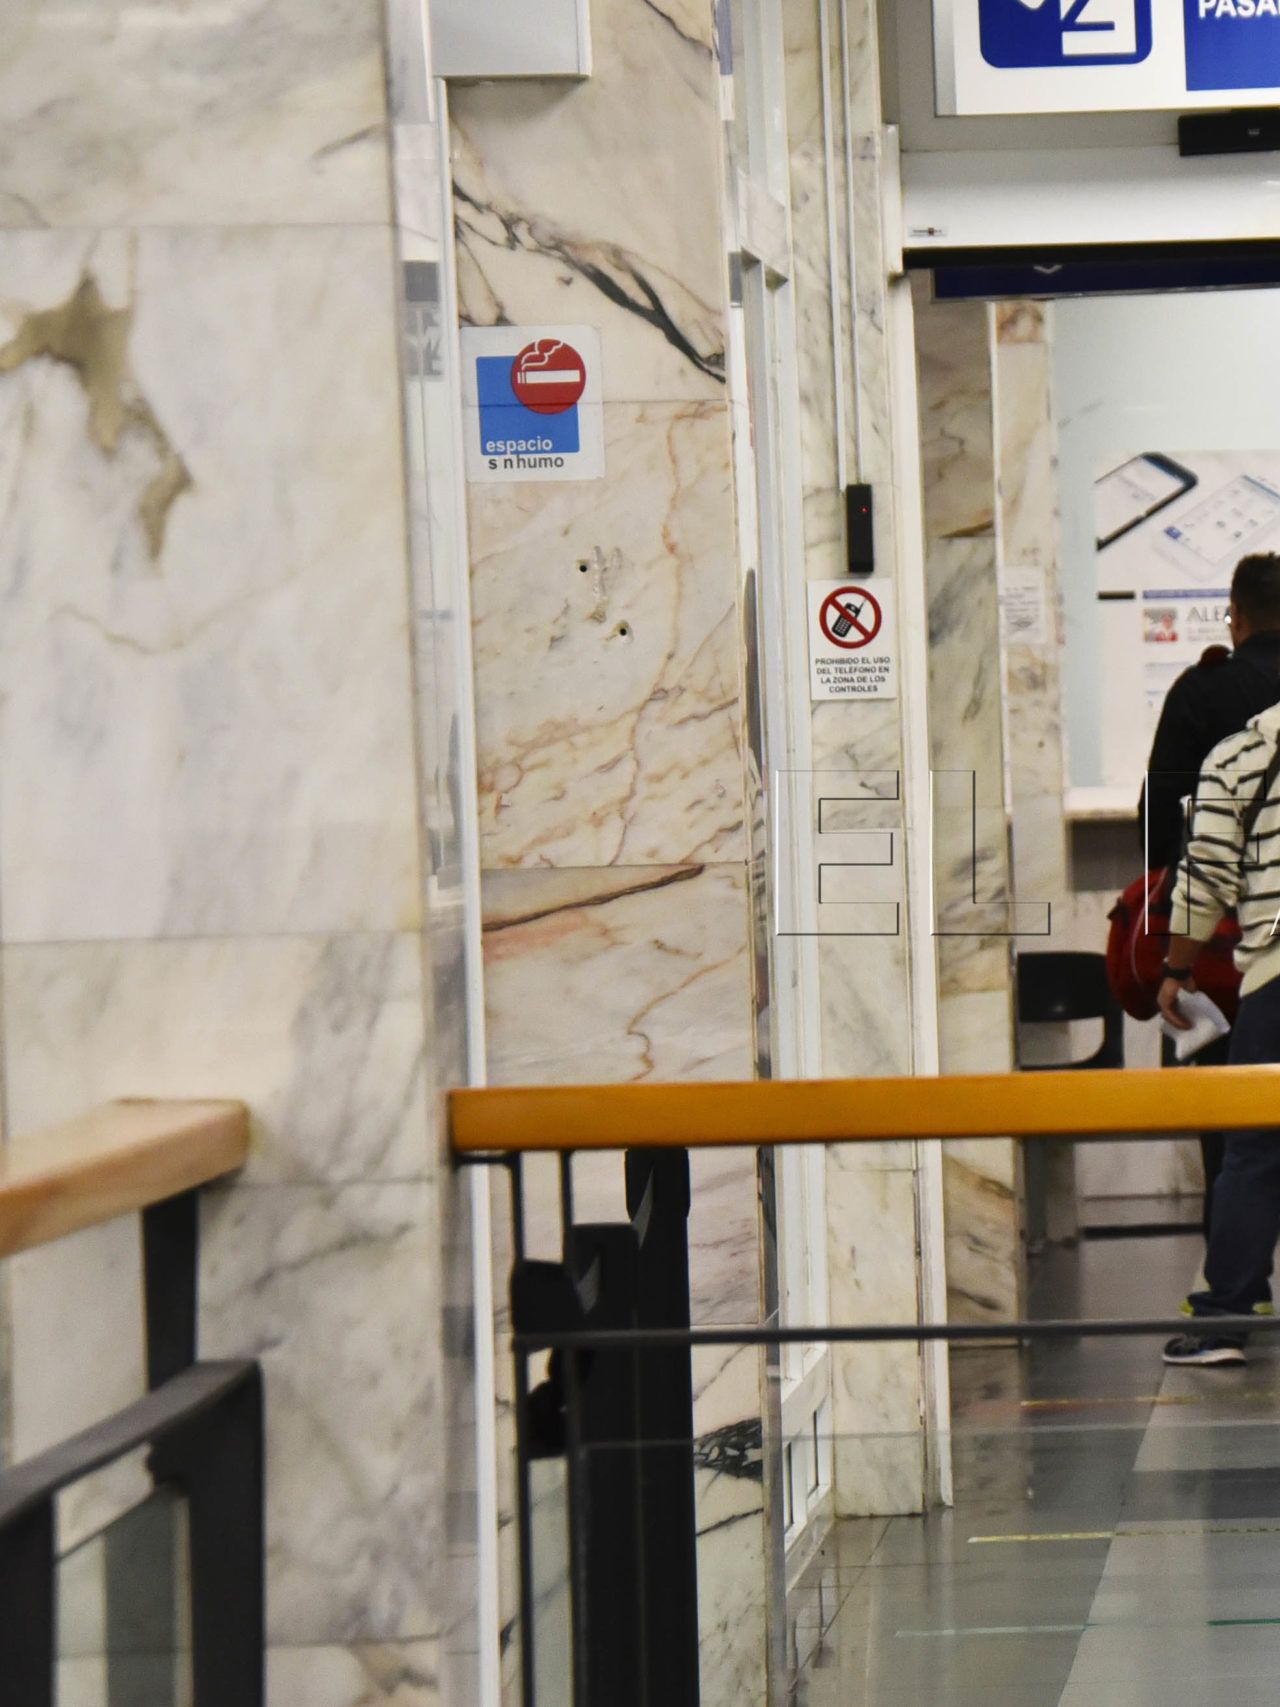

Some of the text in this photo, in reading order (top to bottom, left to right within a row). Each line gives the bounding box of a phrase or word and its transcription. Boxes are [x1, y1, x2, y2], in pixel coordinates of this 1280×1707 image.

[486, 435, 553, 455] espacio
[516, 455, 565, 469] humo
[815, 657, 859, 665] PROHIBIDO
[873, 656, 890, 664] USO
[833, 676, 855, 684] ZONA
[870, 675, 886, 683] LOS
[829, 685, 878, 693] CONTROLES
